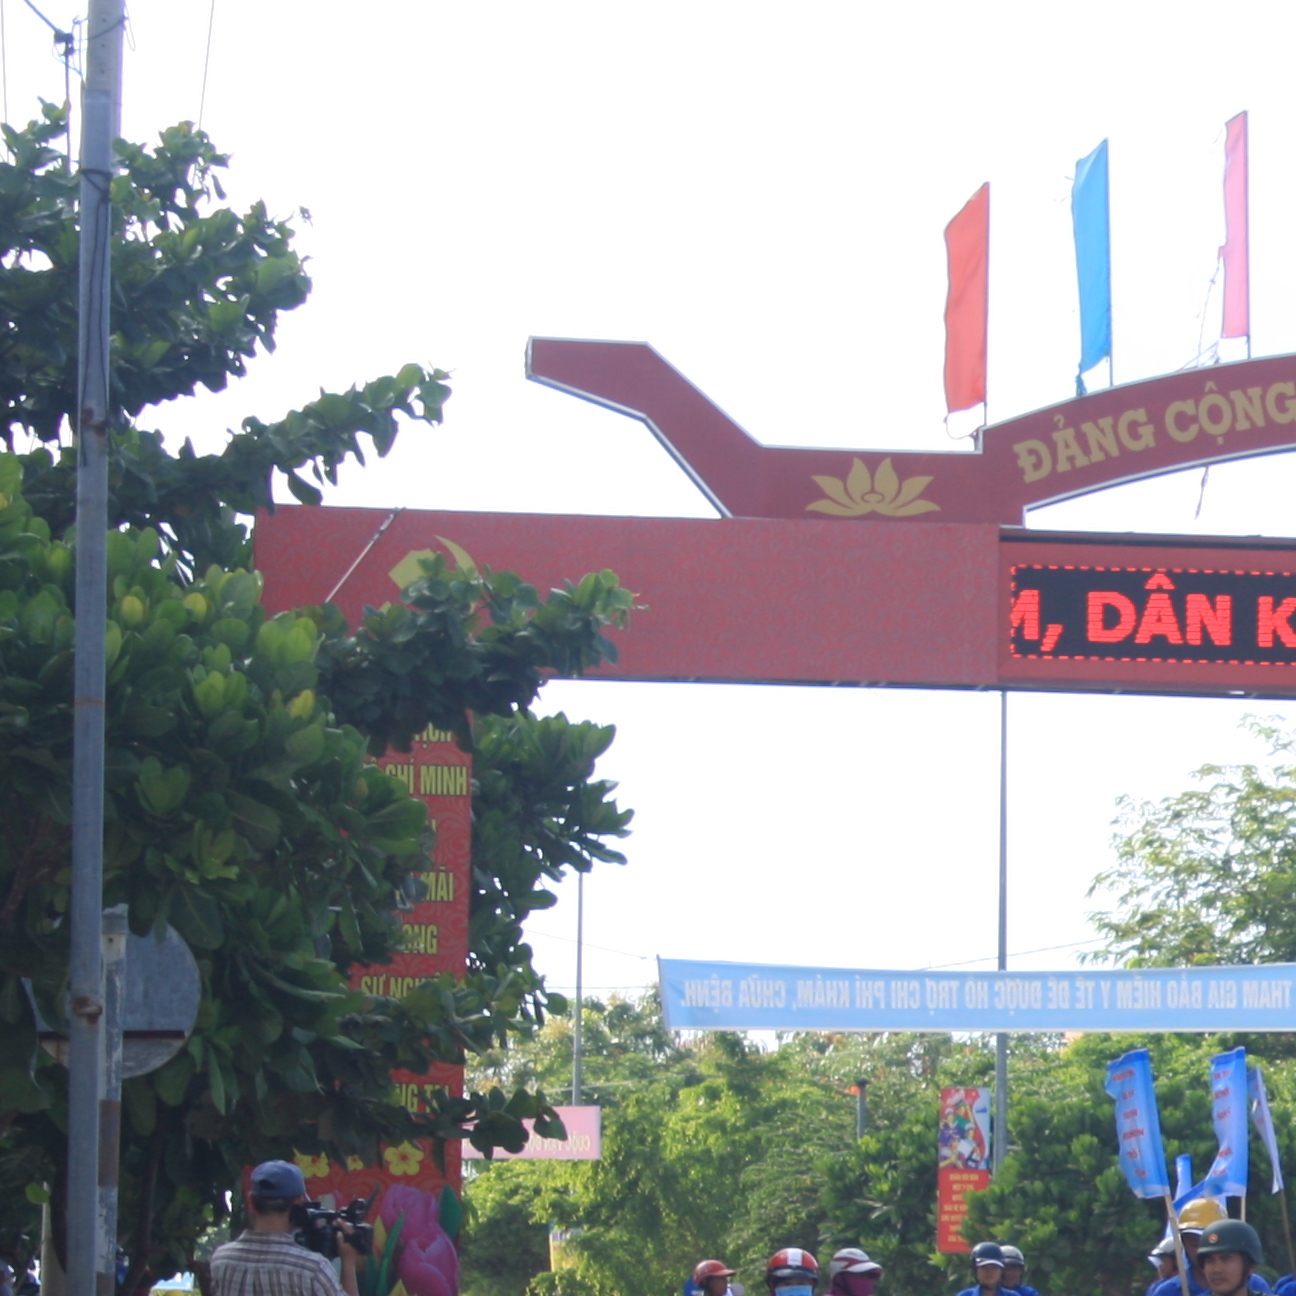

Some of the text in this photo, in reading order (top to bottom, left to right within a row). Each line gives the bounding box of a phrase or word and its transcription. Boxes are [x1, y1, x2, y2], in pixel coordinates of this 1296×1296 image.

[1013, 414, 1155, 483] ĐẢNG
[1087, 573, 1232, 647] DÂN
[421, 765, 467, 796] MINH
